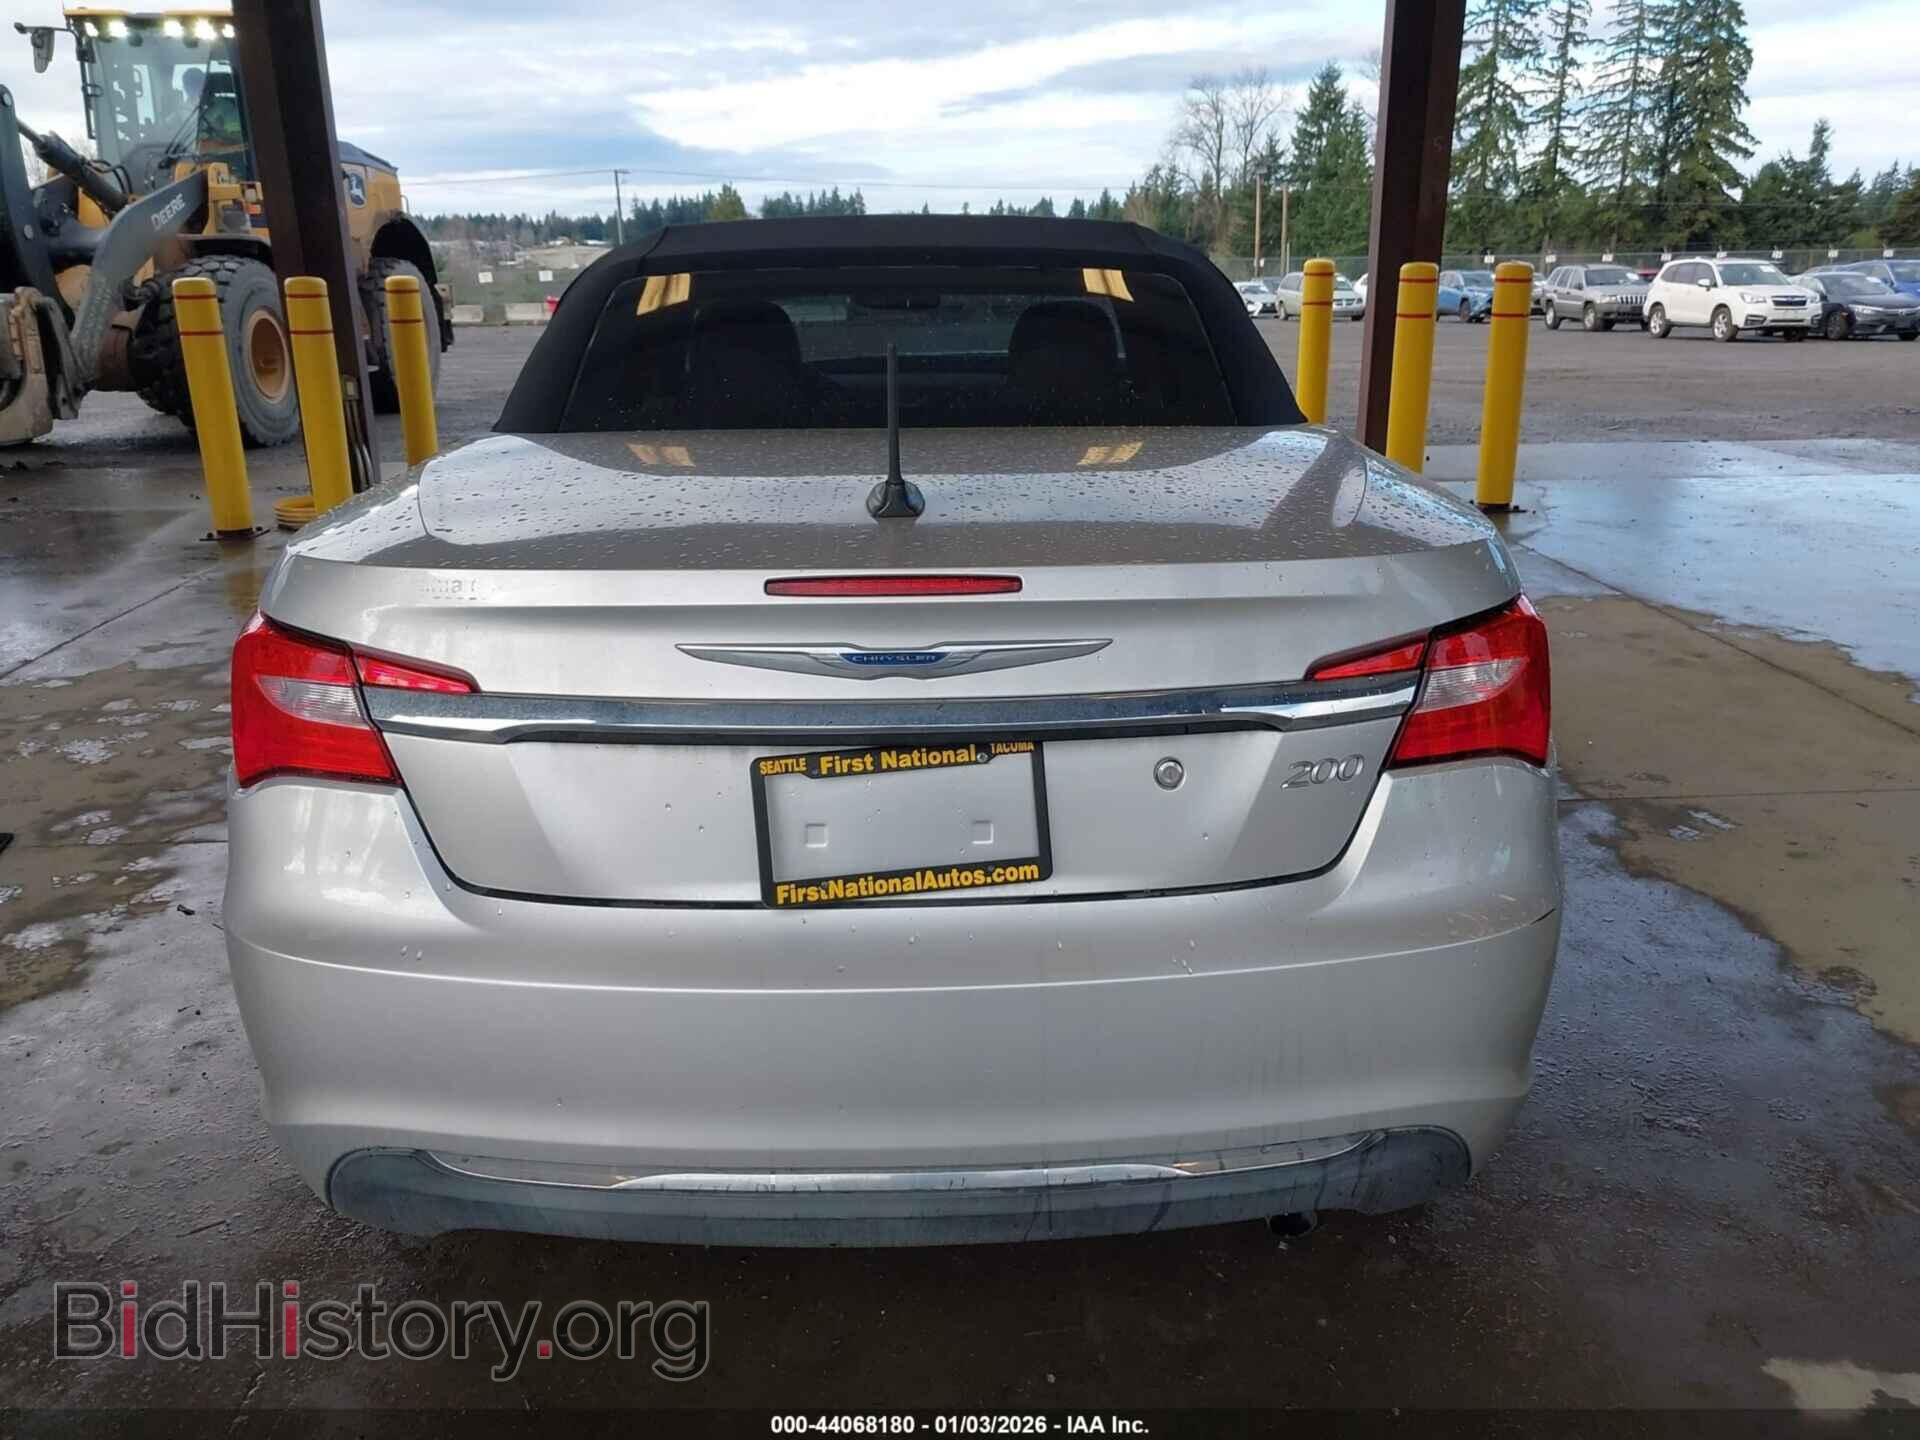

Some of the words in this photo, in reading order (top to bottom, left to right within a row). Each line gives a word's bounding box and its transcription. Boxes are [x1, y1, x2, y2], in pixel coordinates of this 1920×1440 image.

[150, 193, 186, 232] DEERE
[852, 654, 936, 663] CHRYSLER
[819, 752, 875, 775] First
[880, 744, 976, 770] National
[991, 741, 1035, 754] TACOMA
[759, 757, 807, 776] SEATTLE
[1280, 754, 1366, 790] 200
[776, 863, 1039, 905] FirstNationalAutos.com
